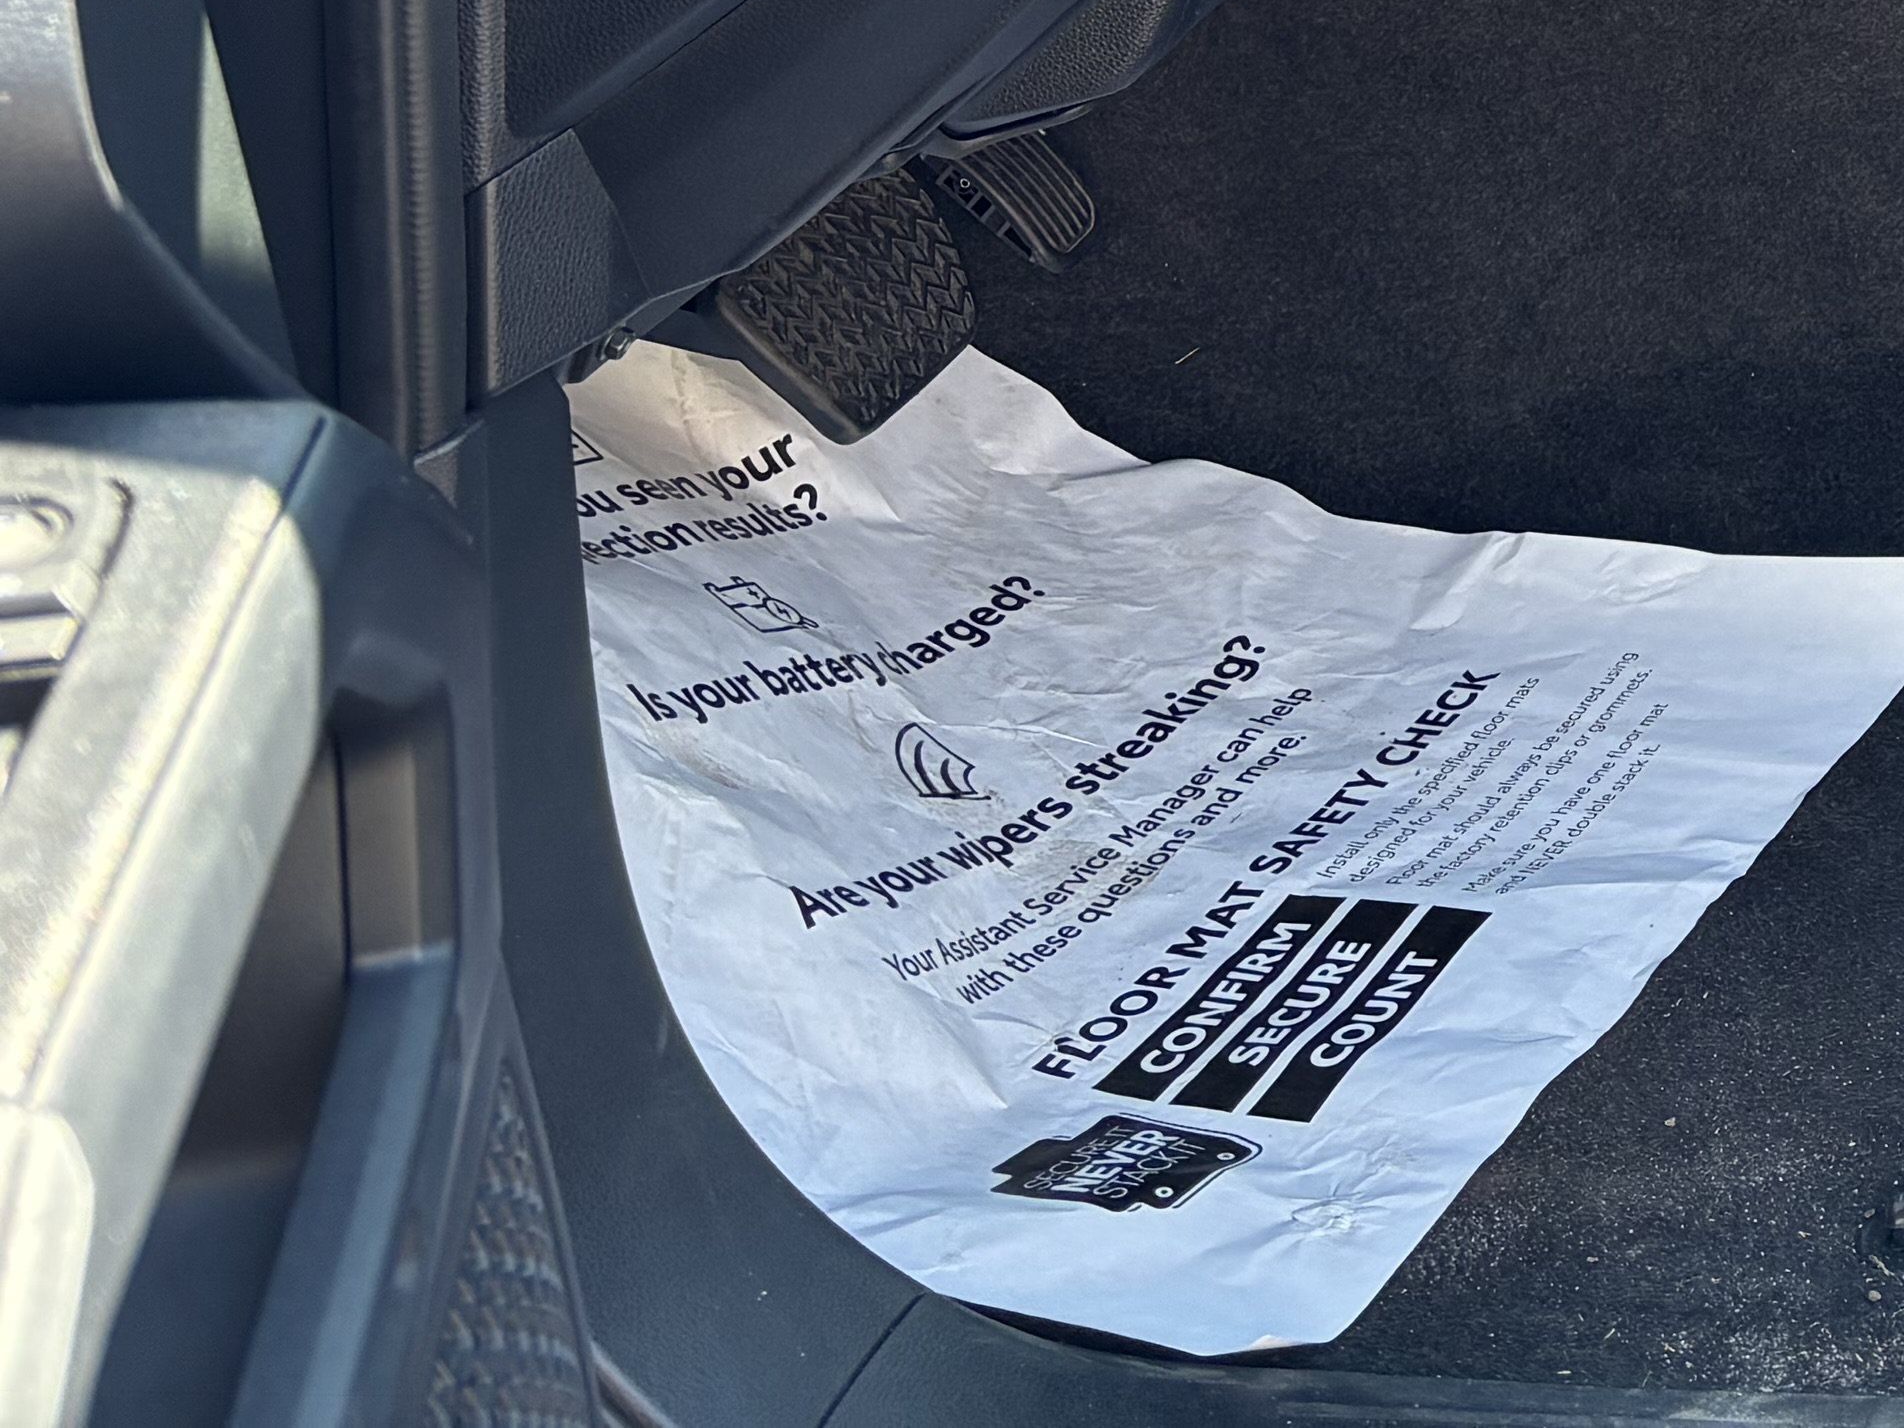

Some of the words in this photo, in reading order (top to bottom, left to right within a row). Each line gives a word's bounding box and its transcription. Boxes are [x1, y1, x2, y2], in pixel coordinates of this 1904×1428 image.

[616, 474, 708, 507] seen
[694, 432, 798, 502] your
[692, 482, 829, 543] results?
[626, 684, 678, 722] Is
[666, 674, 758, 724] your
[742, 652, 887, 697] battery
[877, 575, 1045, 676] charged?
[788, 885, 870, 930] Are
[854, 856, 947, 909] your
[937, 796, 1074, 870] wipers
[1065, 635, 1266, 796] streaking?
[881, 948, 939, 981] Your
[935, 910, 1037, 966] Assistant
[1023, 847, 1121, 916] Service
[1108, 764, 1219, 848] Manager
[1216, 717, 1265, 763] can
[1259, 688, 1313, 727] help
[1316, 840, 1370, 879] Install
[1365, 816, 1400, 839] only
[1392, 797, 1422, 815] the
[1417, 741, 1480, 796] specified
[1470, 710, 1509, 740] floor
[1505, 677, 1540, 709] mats
[1349, 827, 1418, 883] designed
[1408, 810, 1437, 827] for
[1432, 784, 1468, 812] your
[1464, 740, 1512, 783] vehicle.
[1384, 859, 1429, 885] Floor
[1426, 835, 1459, 859] mat
[1453, 795, 1502, 835] should
[1498, 753, 1542, 794] always
[1538, 735, 1561, 752] be
[1555, 686, 1606, 735] secured
[1599, 652, 1640, 685] using
[1416, 864, 1449, 887] the
[1439, 833, 1496, 871] factory
[1489, 778, 1550, 833] retention
[1544, 749, 1578, 776] clips
[1573, 733, 1591, 747] or
[1587, 669, 1653, 733] grommets.
[1462, 866, 1507, 893] Make
[1501, 843, 1536, 866] sure
[1531, 818, 1561, 843] you
[1555, 786, 1592, 815] have
[1586, 761, 1616, 785] one
[1606, 729, 1644, 759] floor
[1639, 703, 1669, 727] mat
[1494, 875, 1526, 895] and
[1519, 840, 1573, 875] NEVER
[1567, 793, 1617, 838] double
[1611, 759, 1648, 792] stack
[955, 968, 1014, 1005] with
[1001, 925, 1083, 973] these
[1077, 828, 1196, 924] questions
[1190, 787, 1244, 826] and
[1235, 736, 1307, 784] more.
[1032, 966, 1190, 1080] FLOOR
[1168, 880, 1265, 960] MAT
[1248, 768, 1388, 875] SAFETY
[1375, 669, 1500, 766] CHECK
[1140, 922, 1312, 1074] CONFIRM
[1228, 940, 1372, 1067] SECURE
[1309, 950, 1438, 1068] COUNT
